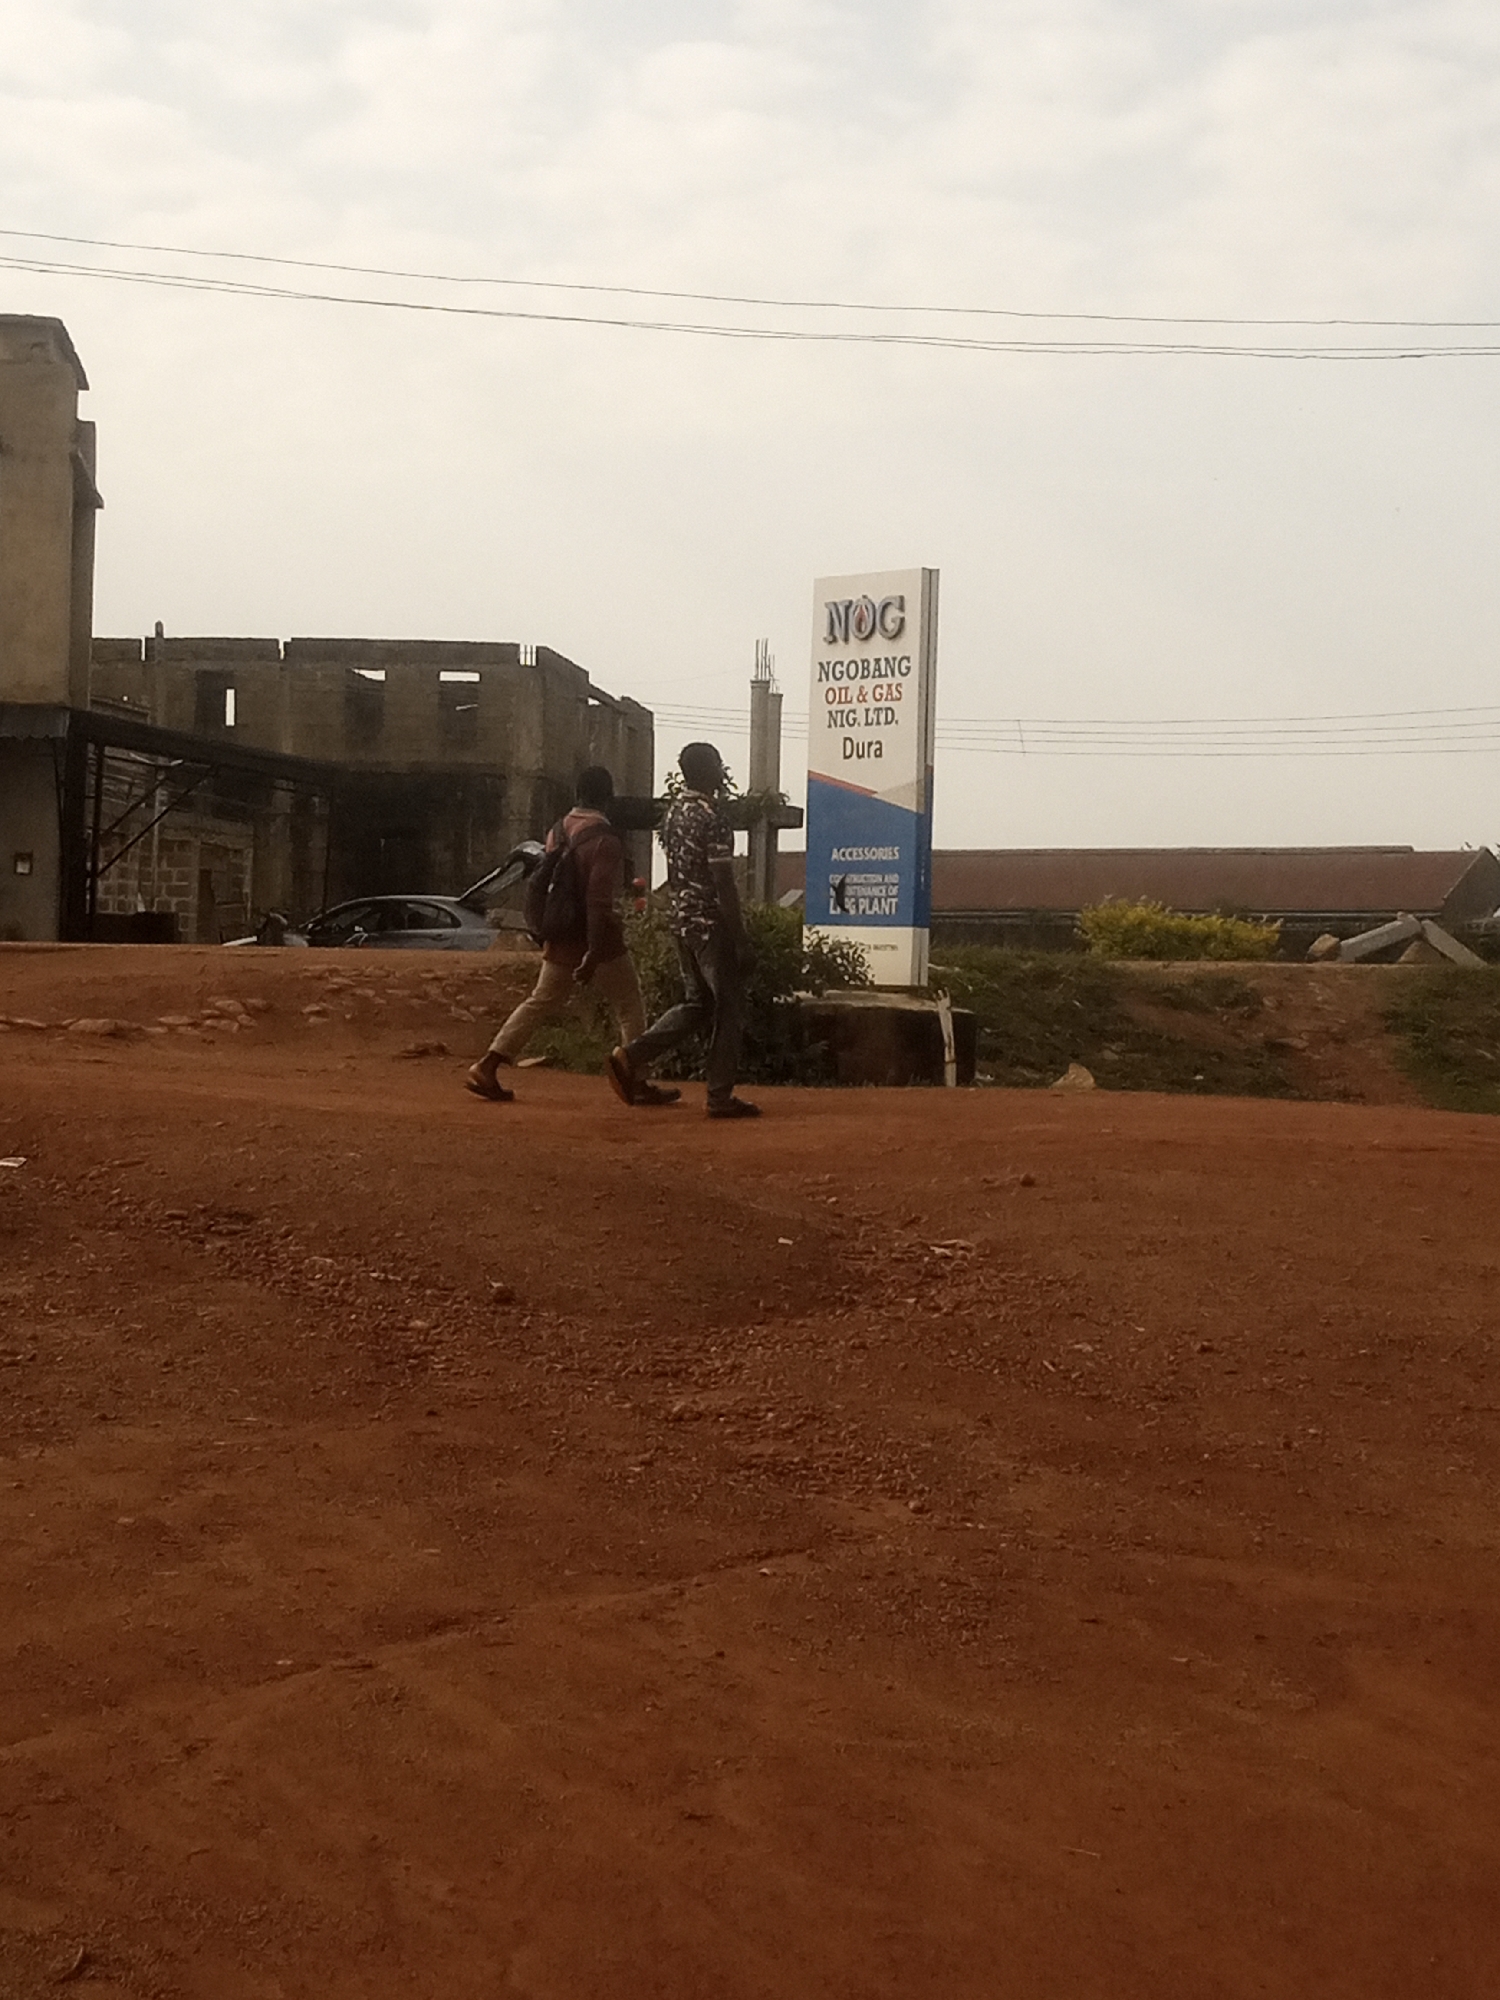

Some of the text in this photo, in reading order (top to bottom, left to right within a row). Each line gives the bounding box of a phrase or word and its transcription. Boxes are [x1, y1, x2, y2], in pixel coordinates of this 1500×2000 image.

[823, 594, 906, 645] NOG
[817, 656, 912, 682] NGOBANG
[825, 682, 903, 705] OIL & GAS
[827, 706, 899, 729] NIG. LTD.
[842, 736, 883, 760] Dura
[831, 846, 900, 861] ACCESSORIES
[884, 873, 899, 883] AND
[887, 885, 899, 896] OF
[858, 897, 899, 915] PLANT
